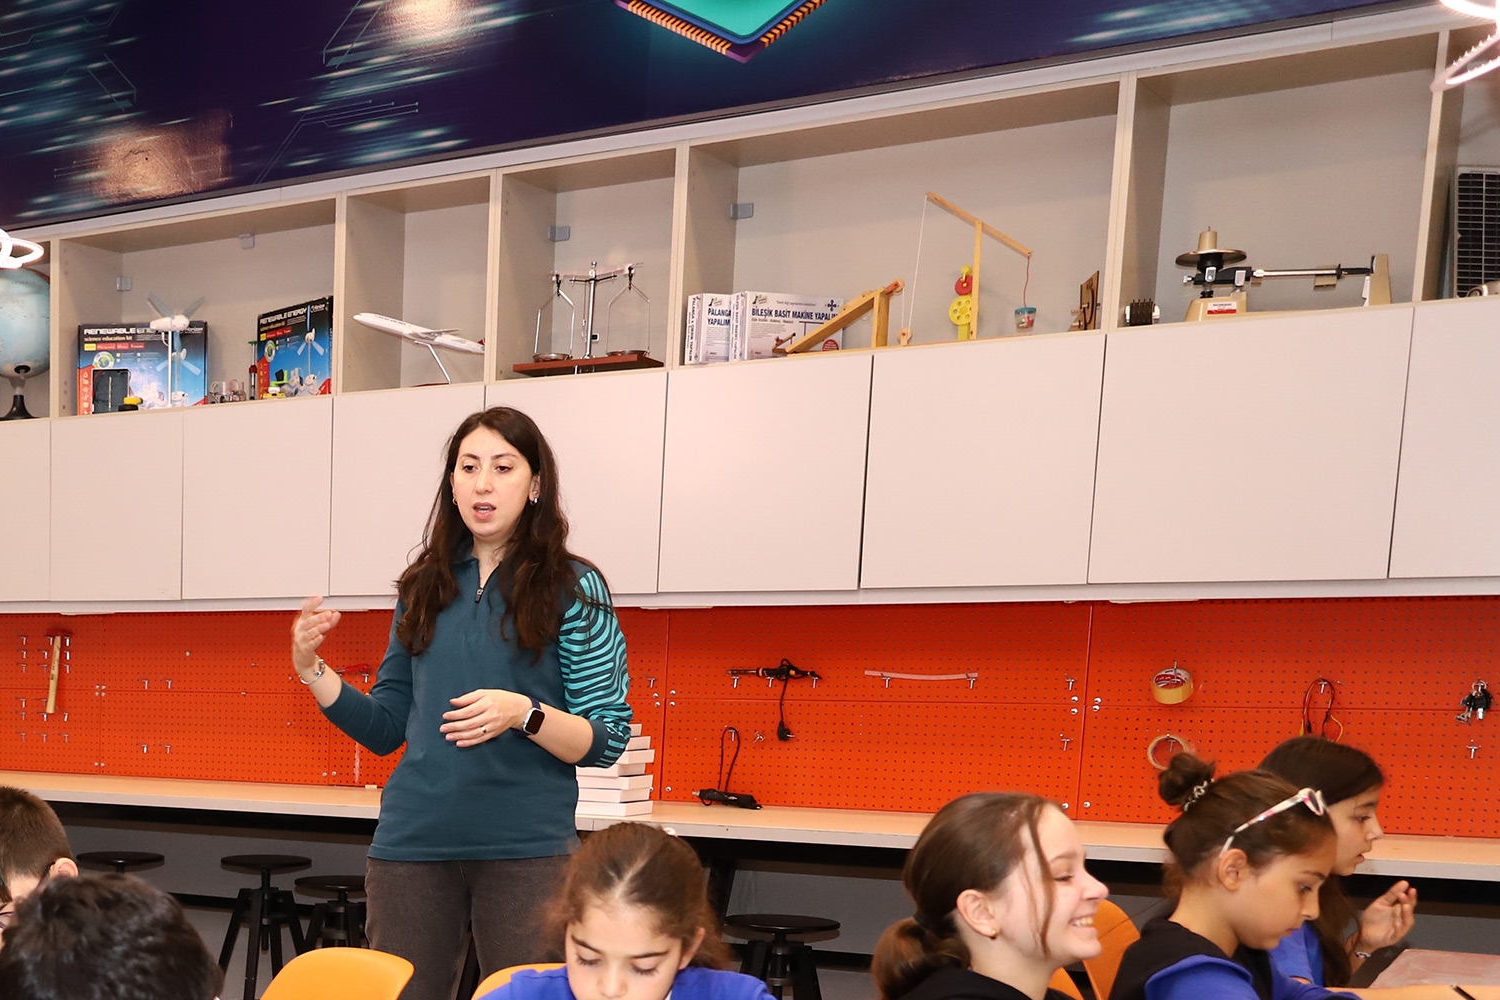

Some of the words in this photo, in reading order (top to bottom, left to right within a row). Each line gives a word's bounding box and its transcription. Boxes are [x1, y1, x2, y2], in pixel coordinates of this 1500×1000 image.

[751, 306, 773, 318] BİLEŞİK
[774, 308, 791, 318] BASİT
[792, 310, 813, 320] MAKİNE
